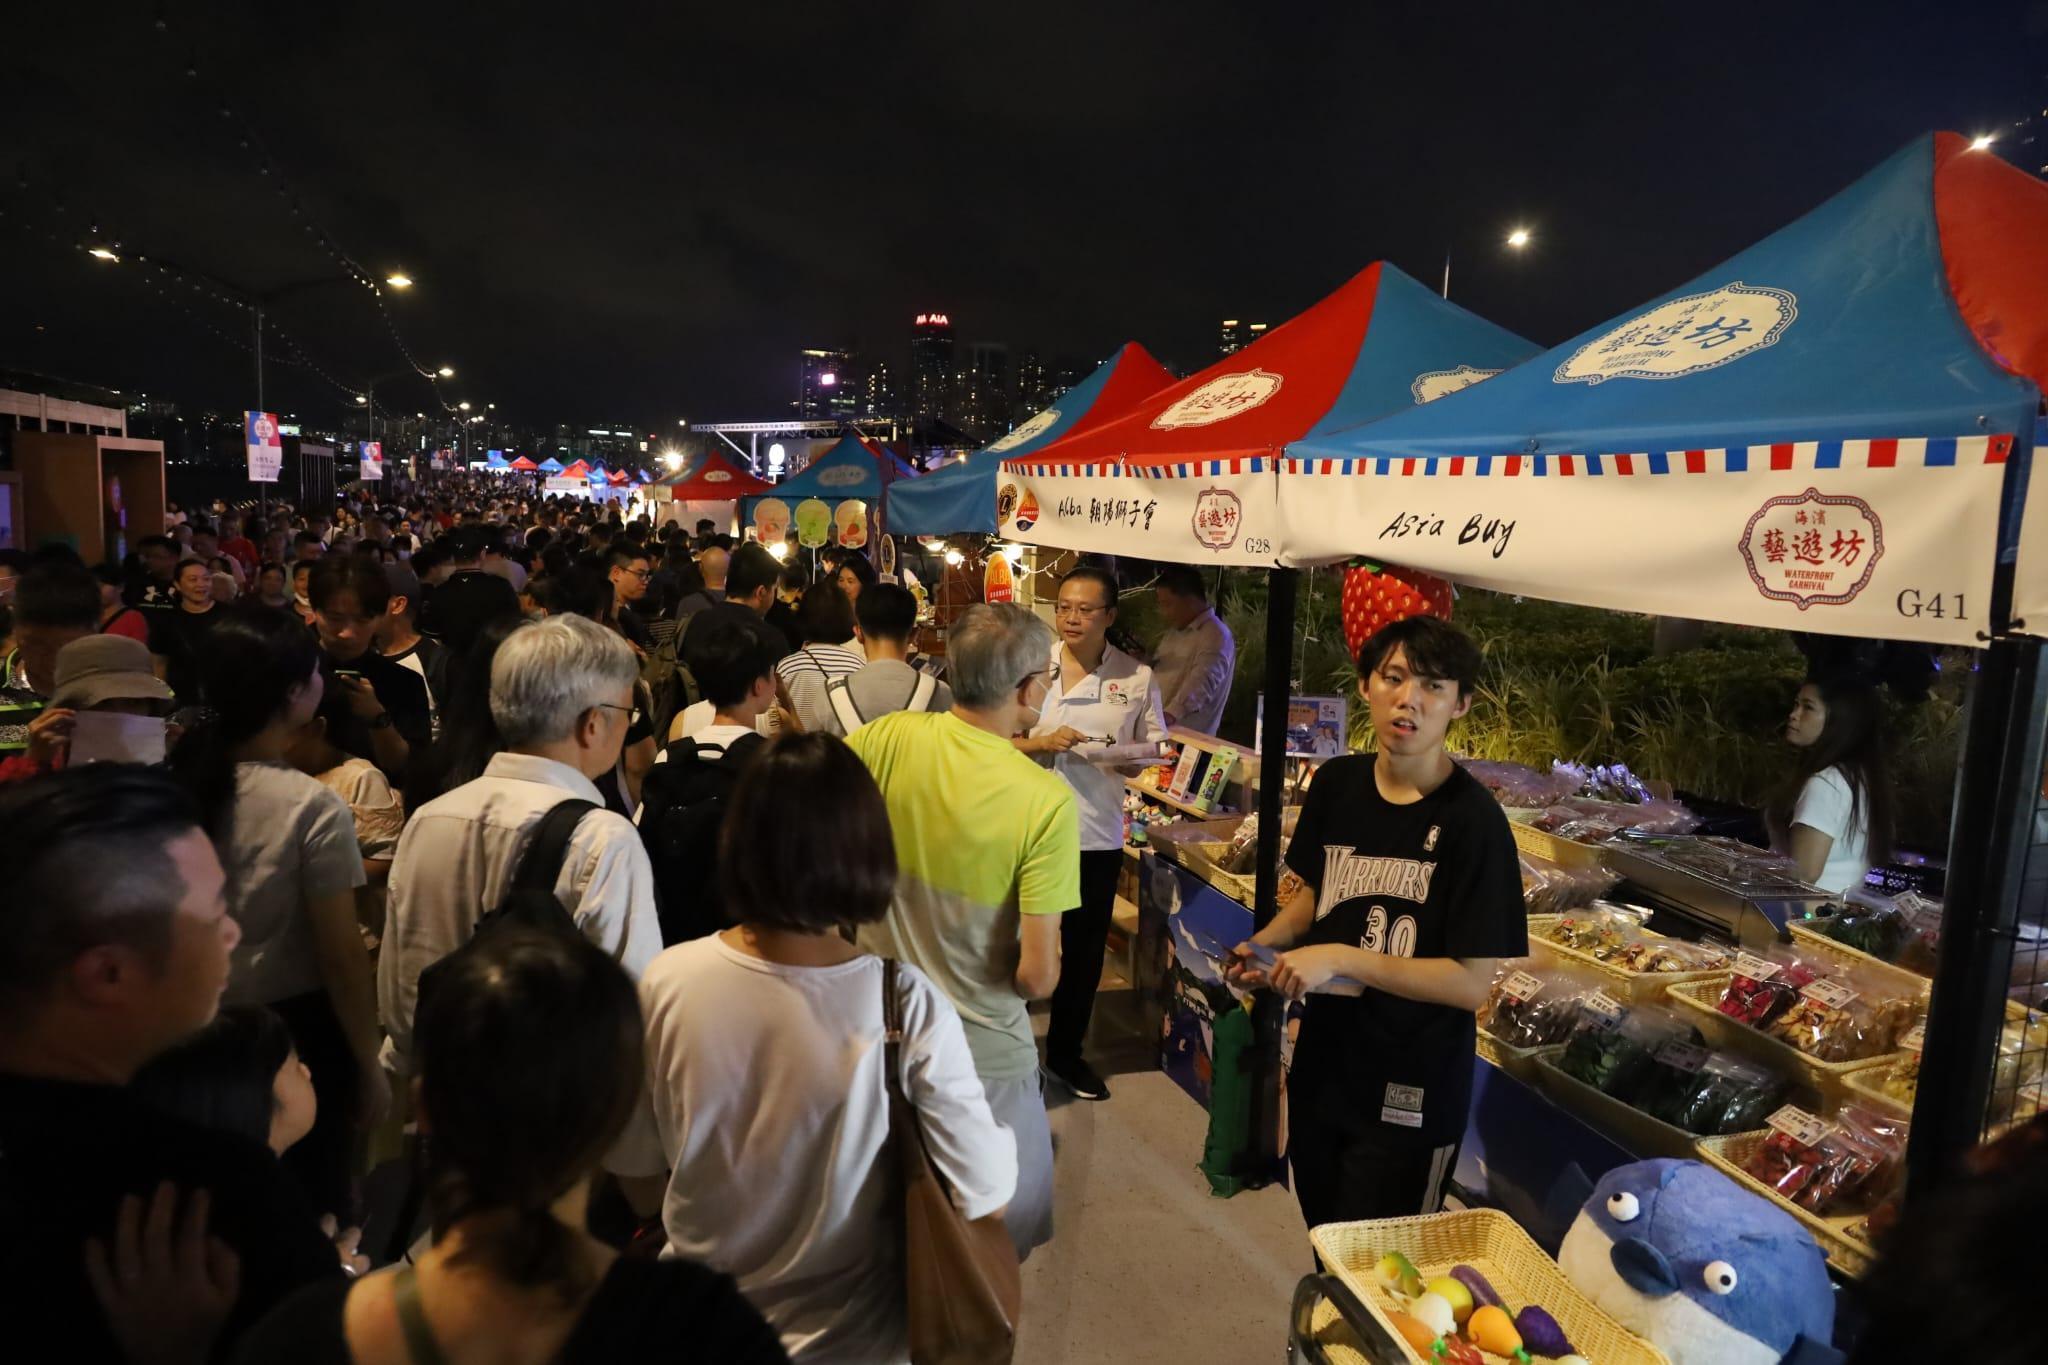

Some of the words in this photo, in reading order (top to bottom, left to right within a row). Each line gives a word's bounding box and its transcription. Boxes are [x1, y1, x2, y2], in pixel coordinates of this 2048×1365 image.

[929, 313, 948, 325] AIA
[1598, 315, 1753, 355] 藝遊坊
[1058, 496, 1083, 518] Alba
[1795, 509, 1827, 526] 海濱
[1245, 537, 1271, 554] G28
[1458, 513, 1517, 559] Buy
[1760, 528, 1866, 567] 藝遊坊
[1784, 569, 1835, 582] WATERFRONT
[1788, 579, 1825, 591] CARNIVAL
[1897, 589, 1969, 620] G41
[1316, 845, 1438, 922] WARRIORS
[1361, 905, 1417, 958] 30
